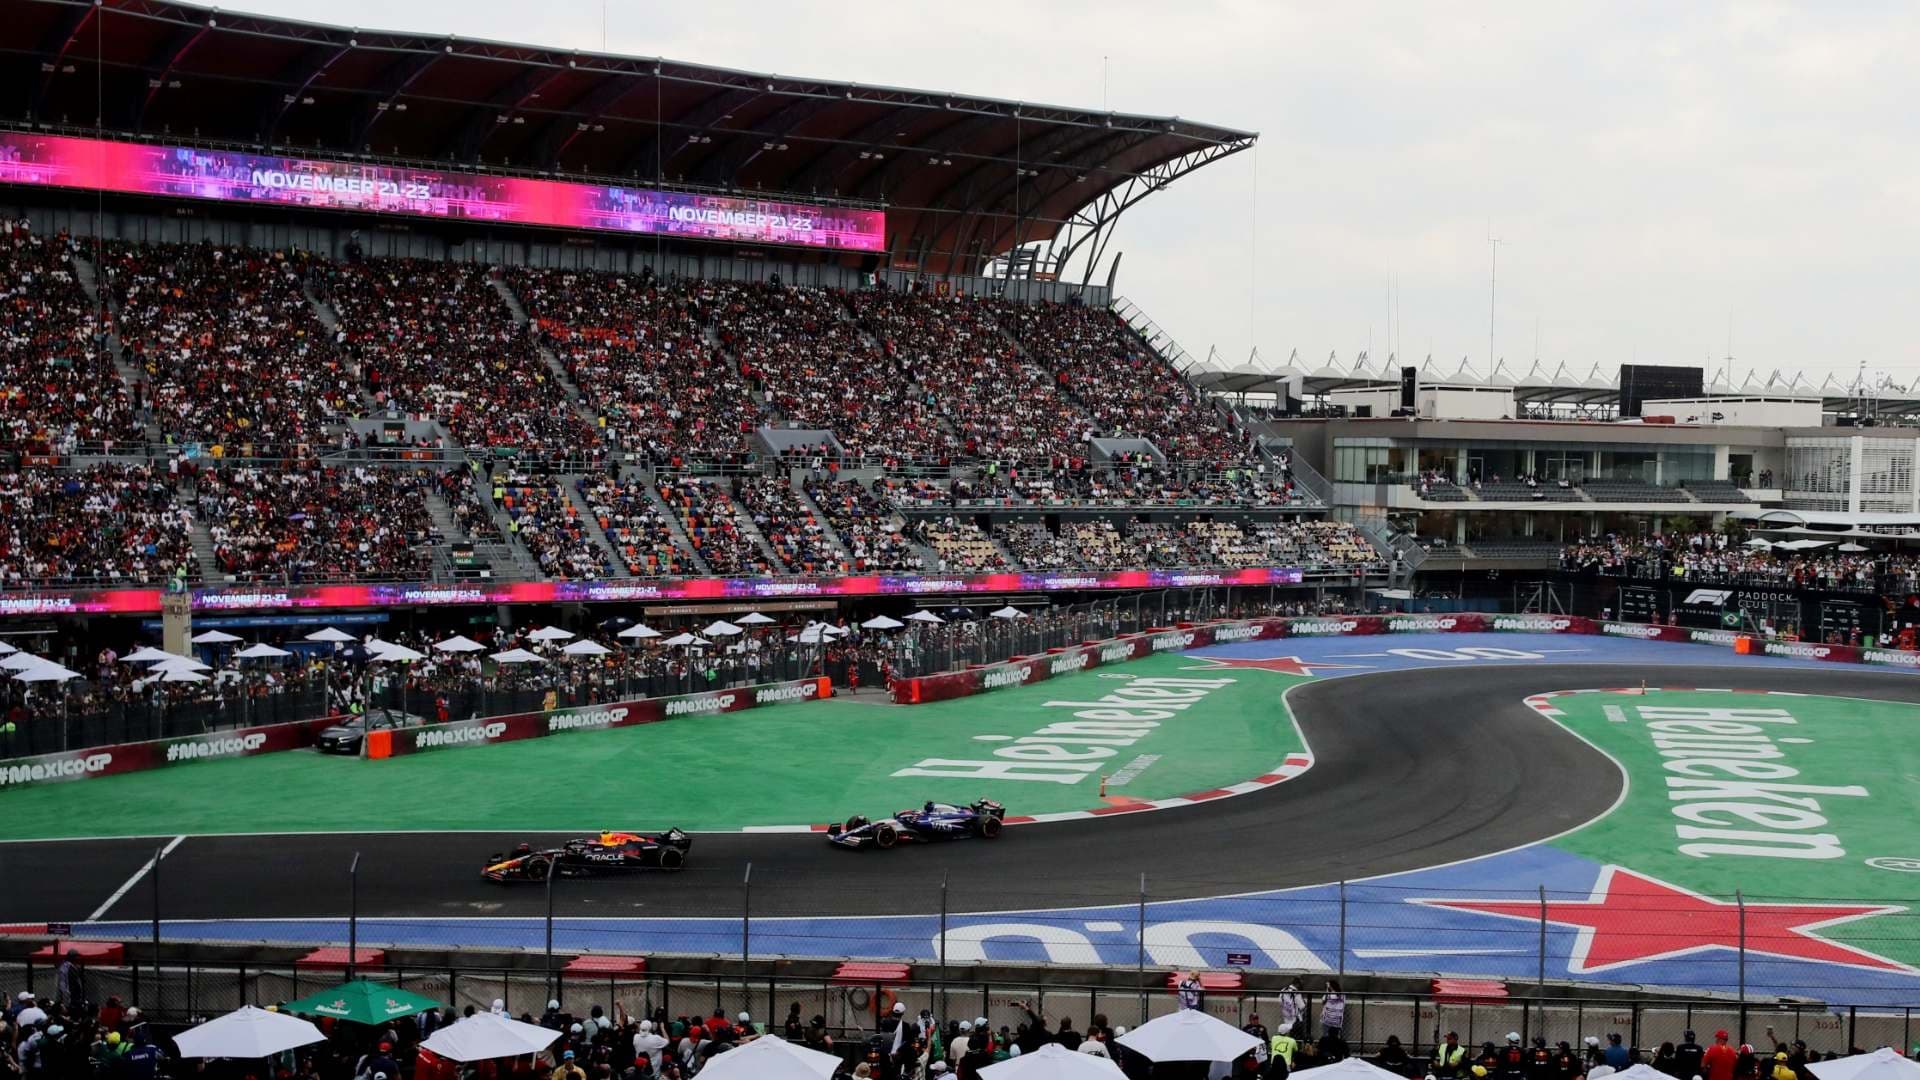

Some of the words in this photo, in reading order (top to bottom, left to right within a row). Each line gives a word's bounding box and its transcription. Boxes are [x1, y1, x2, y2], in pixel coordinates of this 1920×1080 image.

[253, 170, 373, 195] NOVEMBER
[378, 182, 431, 200] 21-23
[669, 207, 768, 228] NOVEMBER
[770, 216, 812, 232] 21-23
[404, 590, 457, 599] NOVEMBER
[589, 587, 638, 595] NOVEMBER
[755, 584, 798, 592] NOVEMBER
[0, 599, 41, 608] EMBER
[42, 598, 70, 606] 21-23
[202, 594, 260, 604] NOVEMBER
[261, 593, 287, 601] 21-23
[1738, 591, 1792, 602] PADDOCK
[1738, 600, 1768, 609] CLUB
[1292, 620, 1358, 634] #MexicoGP
[1388, 618, 1457, 631] #MexicoGP
[1493, 618, 1571, 631] #MexicoGP
[1602, 623, 1662, 638] #MexicoGP
[1214, 625, 1264, 641] #MexicoGP
[1152, 633, 1195, 651] #MexicoGP
[1764, 643, 1831, 658] #MexicoGP
[1051, 653, 1089, 674] #MexicoGP
[984, 666, 1032, 688] #MexicoGP
[755, 683, 818, 703] #MexicoGP
[665, 694, 736, 716] #MexicoGP
[549, 707, 629, 731] #MexicoGP
[415, 721, 507, 748] #MexicoGP
[890, 677, 1238, 785] Heineken
[167, 732, 267, 761] #MexicoGP
[1635, 705, 1870, 860] Heineken
[585, 853, 625, 862] ORACLE
